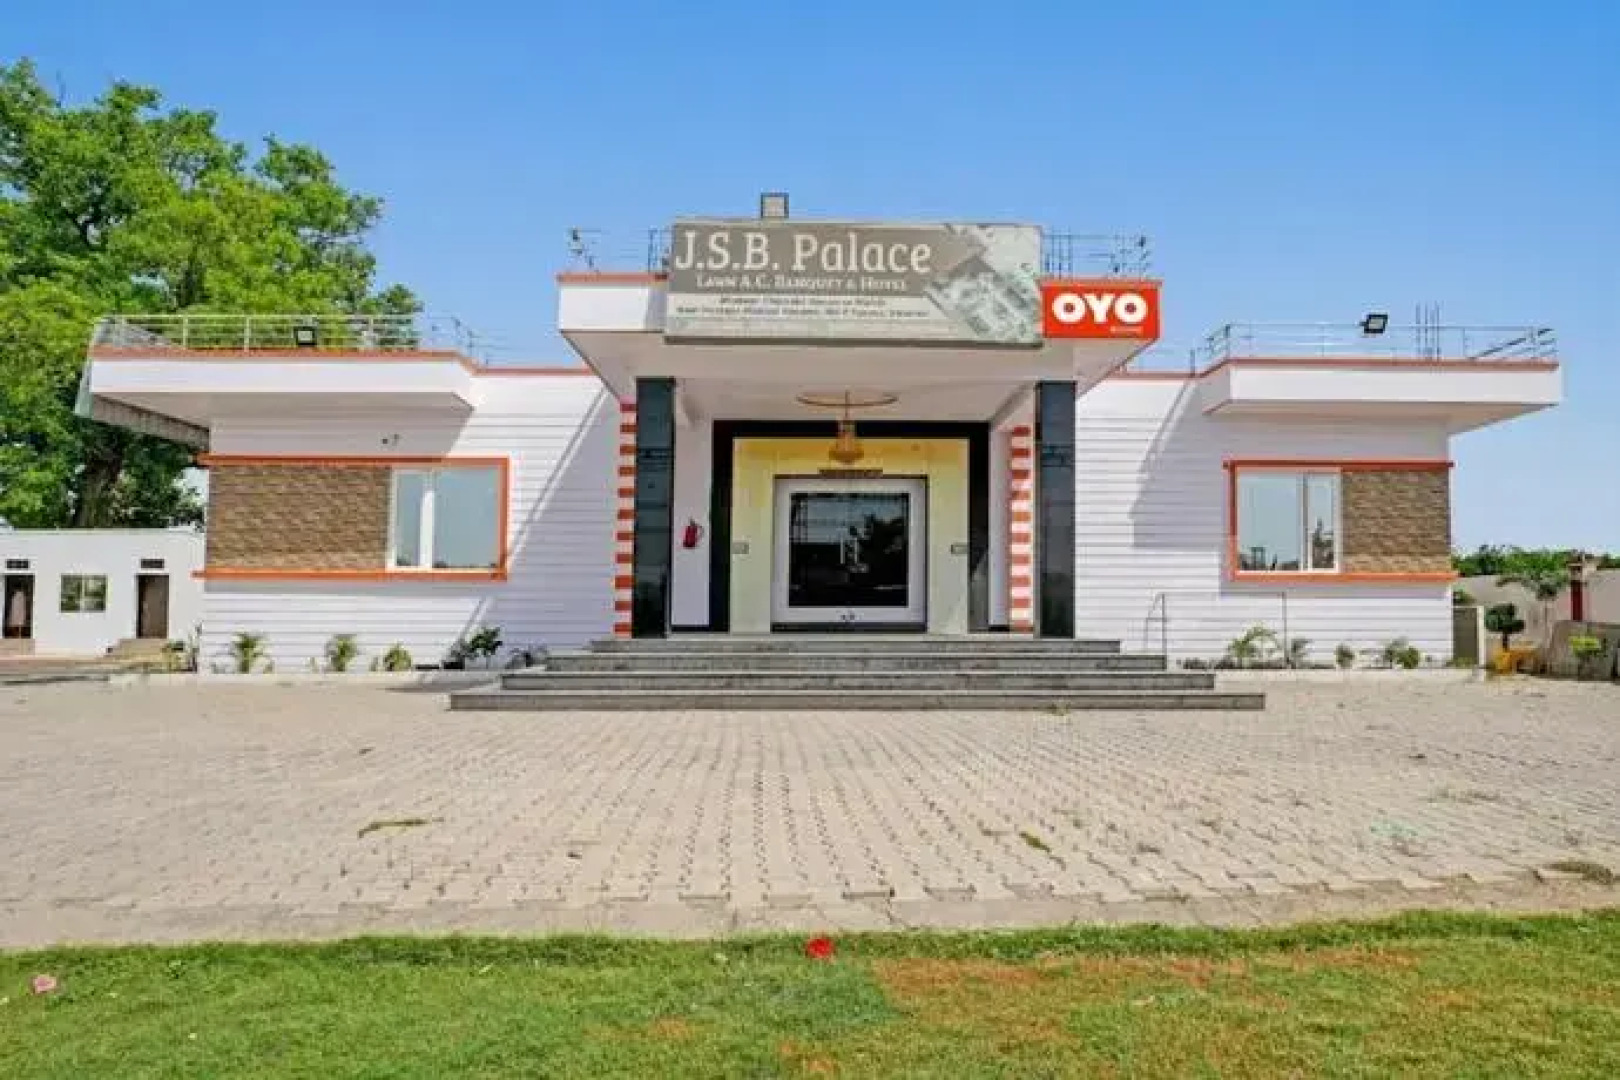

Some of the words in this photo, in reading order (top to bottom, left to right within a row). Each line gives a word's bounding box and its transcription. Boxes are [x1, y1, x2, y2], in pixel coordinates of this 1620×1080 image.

[675, 230, 780, 270] J.S.B.
[791, 231, 932, 273] Palace
[1052, 292, 1148, 324] OYO
